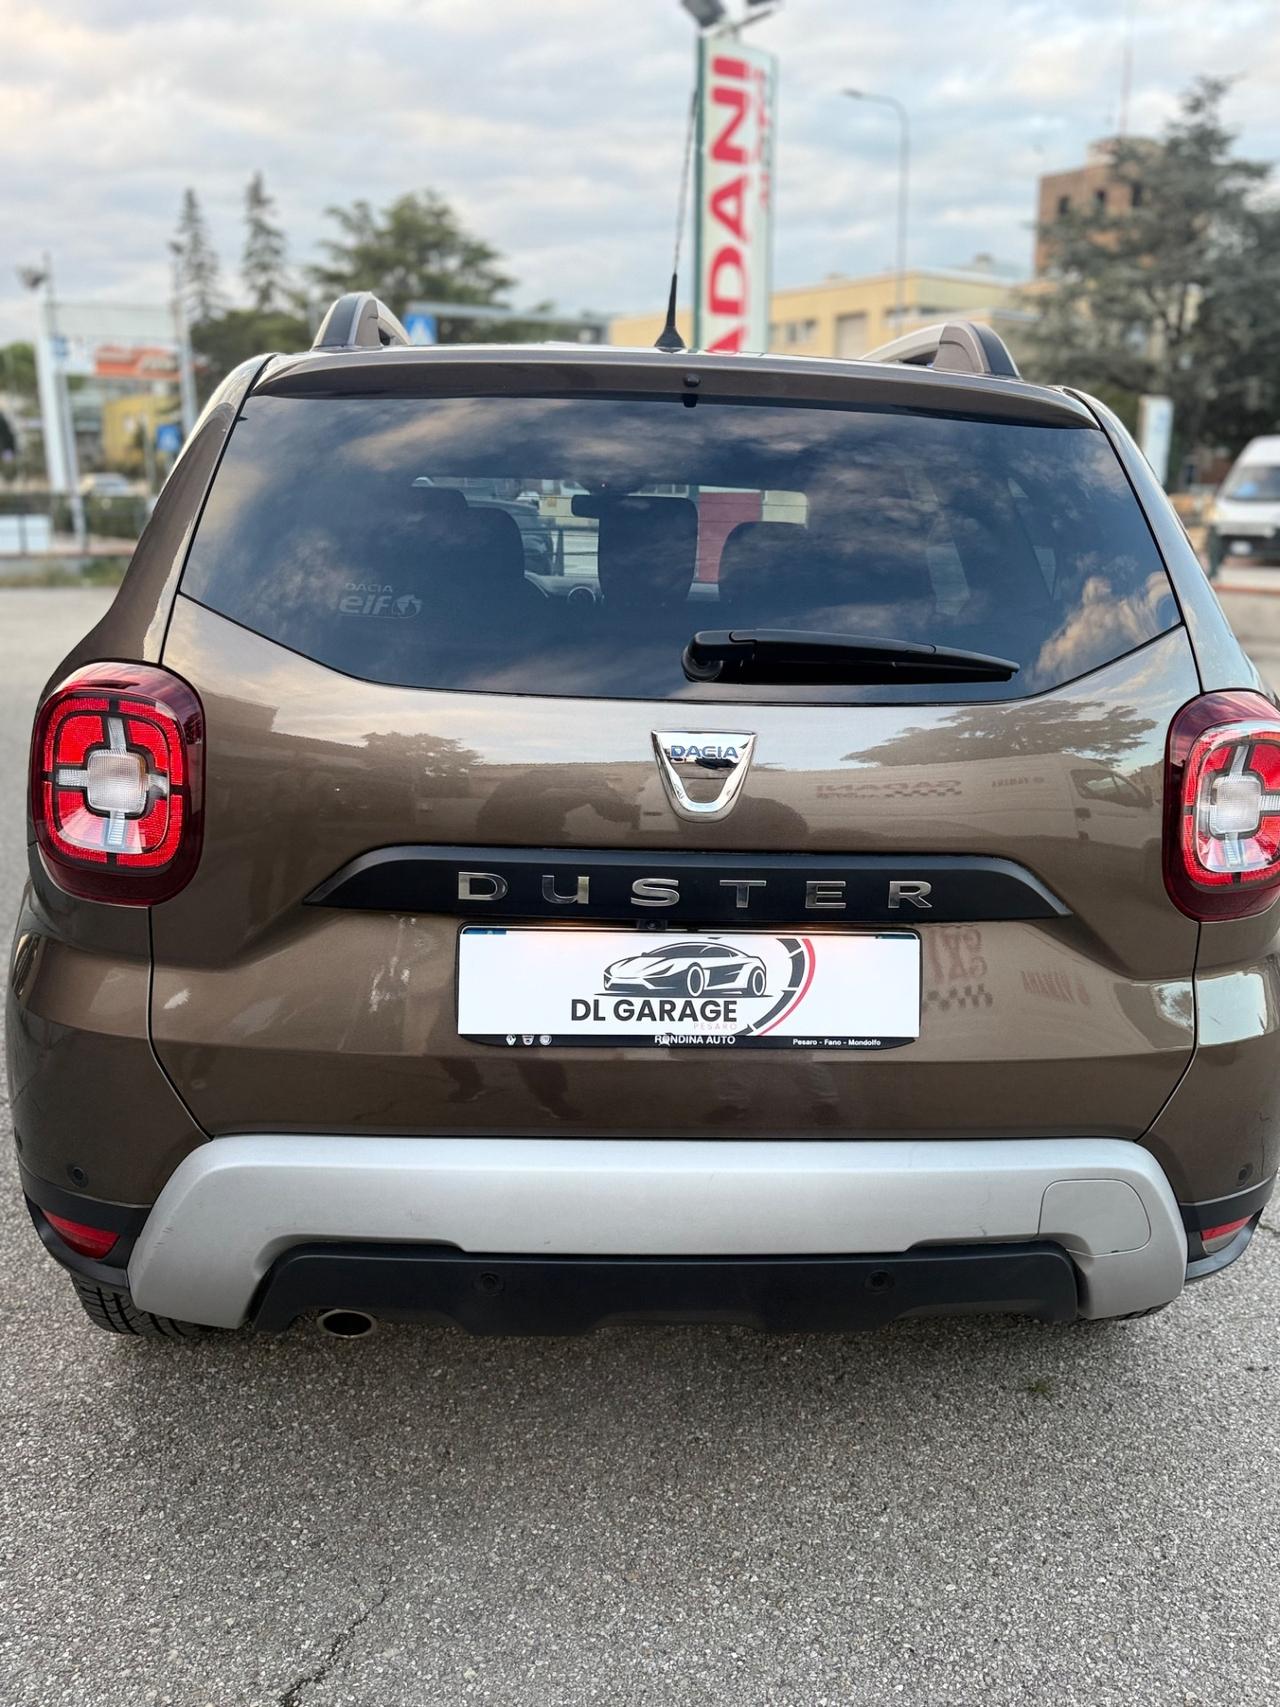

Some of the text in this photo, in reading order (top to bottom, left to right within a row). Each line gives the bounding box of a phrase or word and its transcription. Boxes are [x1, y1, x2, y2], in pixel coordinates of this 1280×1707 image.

[345, 583, 393, 592] DACIA
[339, 595, 392, 614] elf
[670, 744, 739, 759] DACIA
[457, 871, 932, 909] DUSTER
[570, 999, 738, 1023] DL GARAGE
[693, 1022, 738, 1031] PESARO
[654, 1034, 737, 1046] RONDINA AUTO
[793, 1038, 818, 1046] Pesaro
[824, 1038, 842, 1046] Fano
[848, 1038, 882, 1046] Mondolfo
